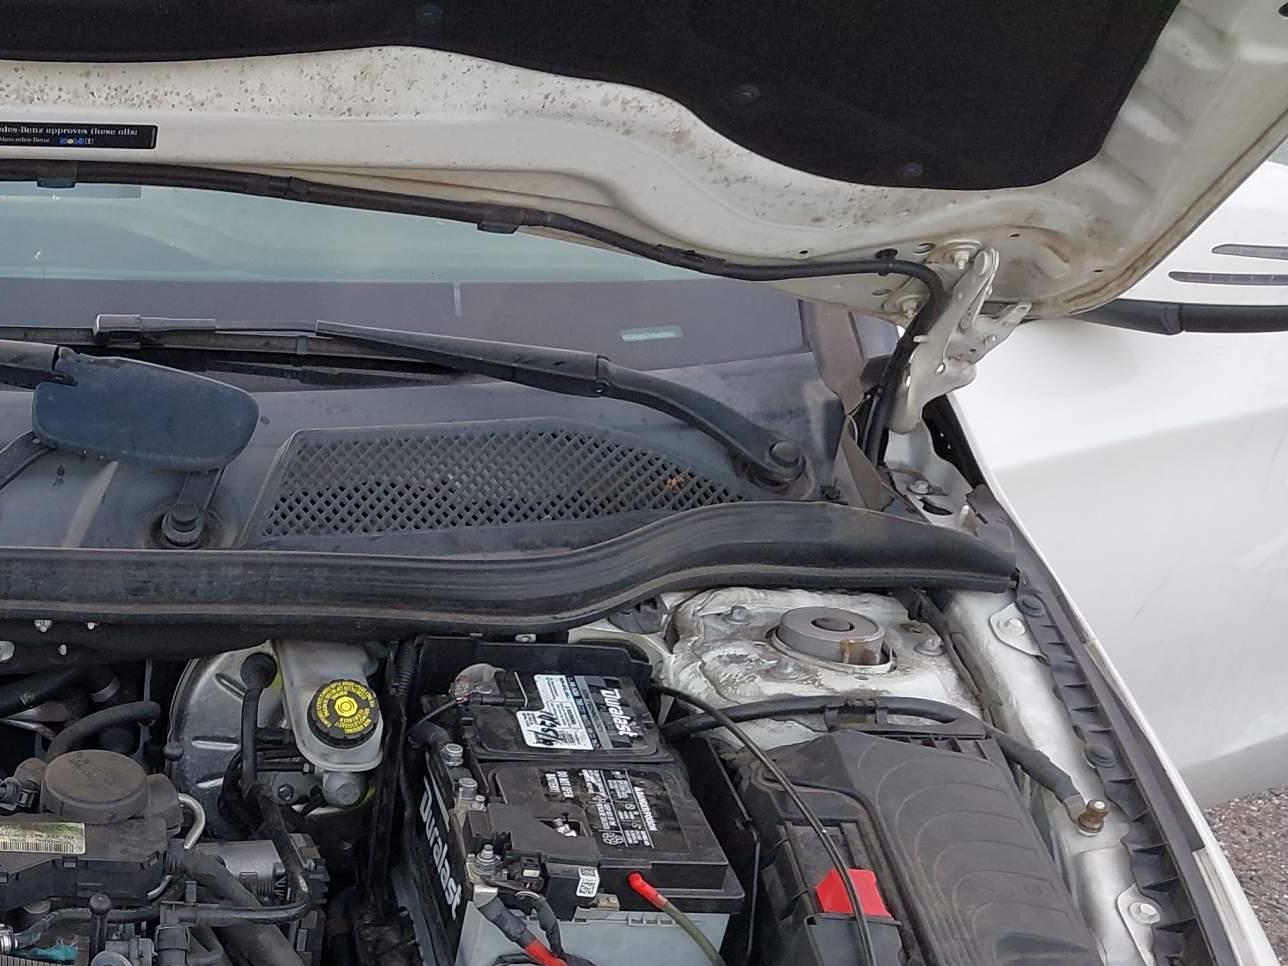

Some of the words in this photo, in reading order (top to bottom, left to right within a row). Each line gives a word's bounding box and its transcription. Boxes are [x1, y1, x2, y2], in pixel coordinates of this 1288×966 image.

[45, 127, 88, 136] approves
[90, 127, 116, 135] these
[600, 688, 640, 739] Duralast
[420, 775, 462, 920] Duralast
